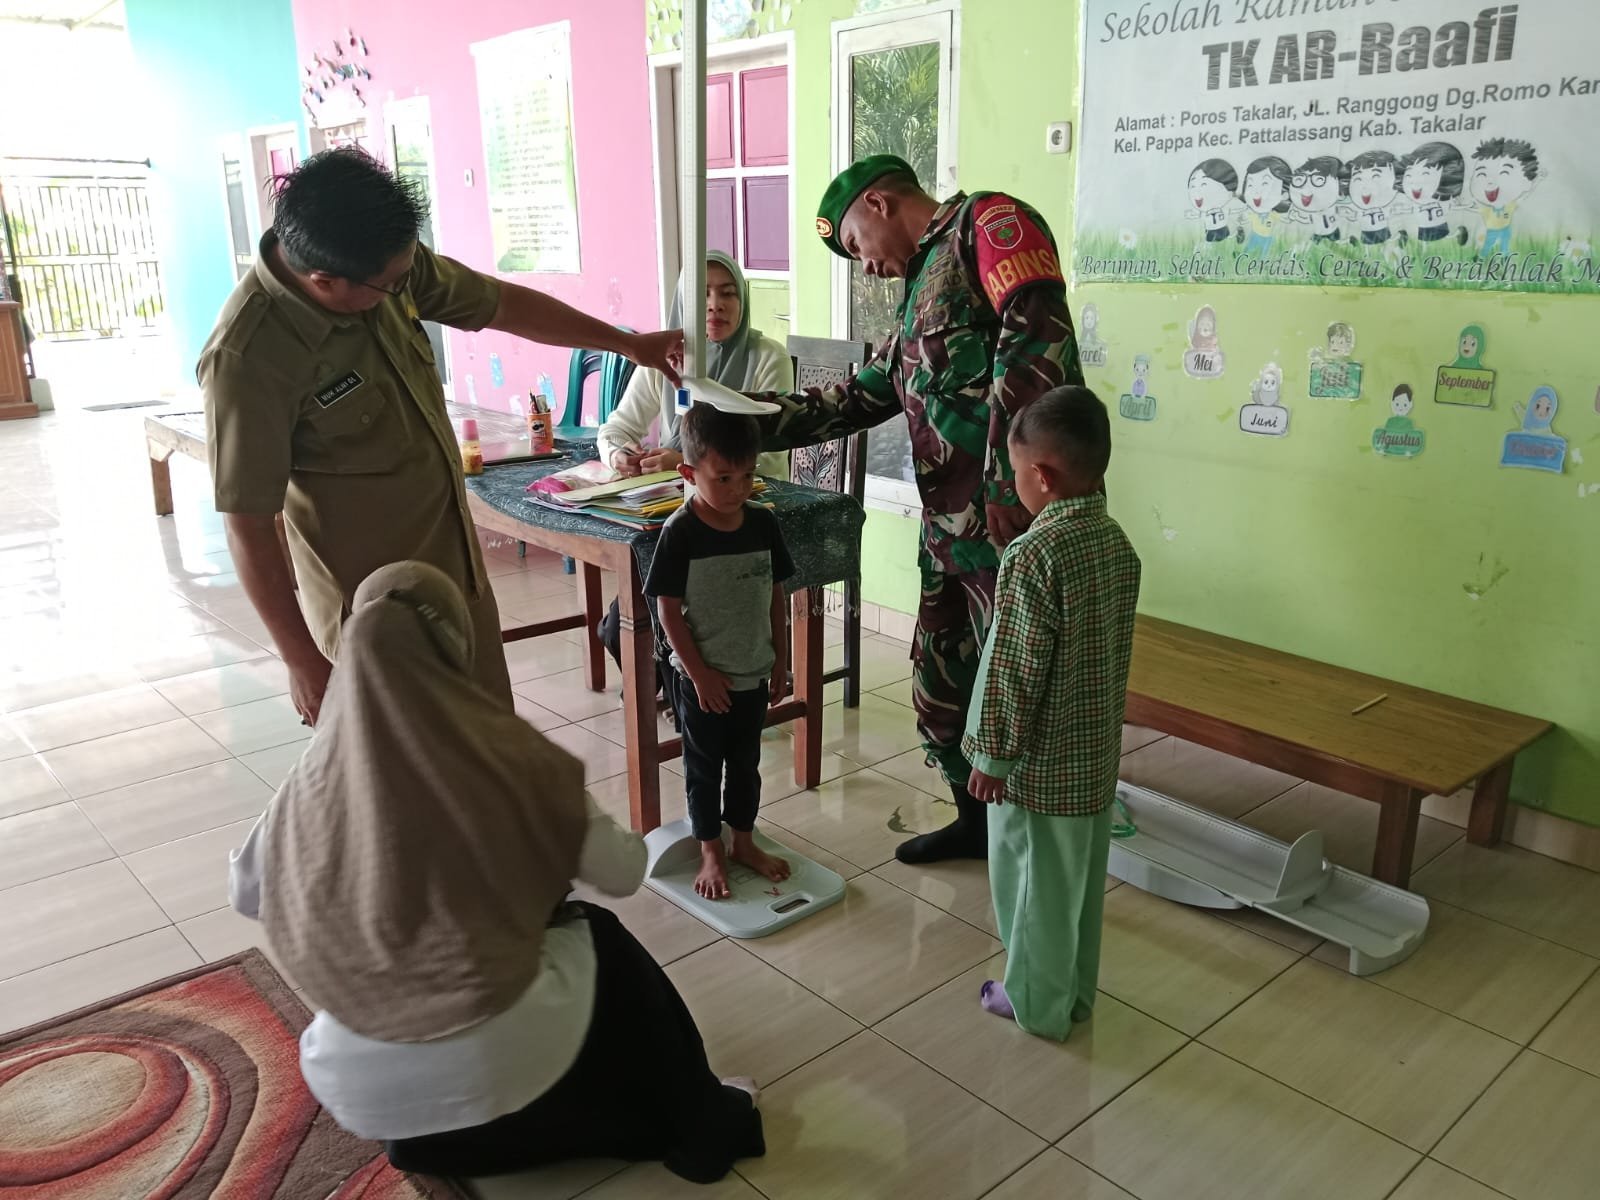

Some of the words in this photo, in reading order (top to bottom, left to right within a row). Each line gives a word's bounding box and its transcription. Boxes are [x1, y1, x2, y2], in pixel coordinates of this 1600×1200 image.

[1100, 0, 1223, 43] Sekolah
[1235, 0, 1375, 24] Ram
[1202, 38, 1261, 91] TK
[1268, 4, 1519, 85] AR-Raafi
[1114, 114, 1165, 132] Alamat
[1180, 110, 1227, 127] Poros
[1232, 102, 1297, 121] Takalar,
[1303, 99, 1330, 117] JL.
[1337, 93, 1439, 116] Ranggong
[1445, 83, 1551, 109] Dg.Romo
[1114, 137, 1141, 153] Kel.
[1146, 135, 1193, 153] Pappa
[1198, 131, 1233, 147] Kec.
[1238, 125, 1352, 144] Pattalassang
[1359, 118, 1402, 137] Kab.
[1410, 113, 1487, 134] Takalar
[1080, 254, 1162, 278] Beriman,
[1168, 251, 1226, 278] Sehat,
[1318, 253, 1386, 281] Ceria,
[1396, 257, 1415, 280] &
[1423, 251, 1566, 284] Berakhlak
[1438, 371, 1491, 391] September
[1250, 413, 1278, 428] Juni
[1376, 430, 1420, 450] Agustus
